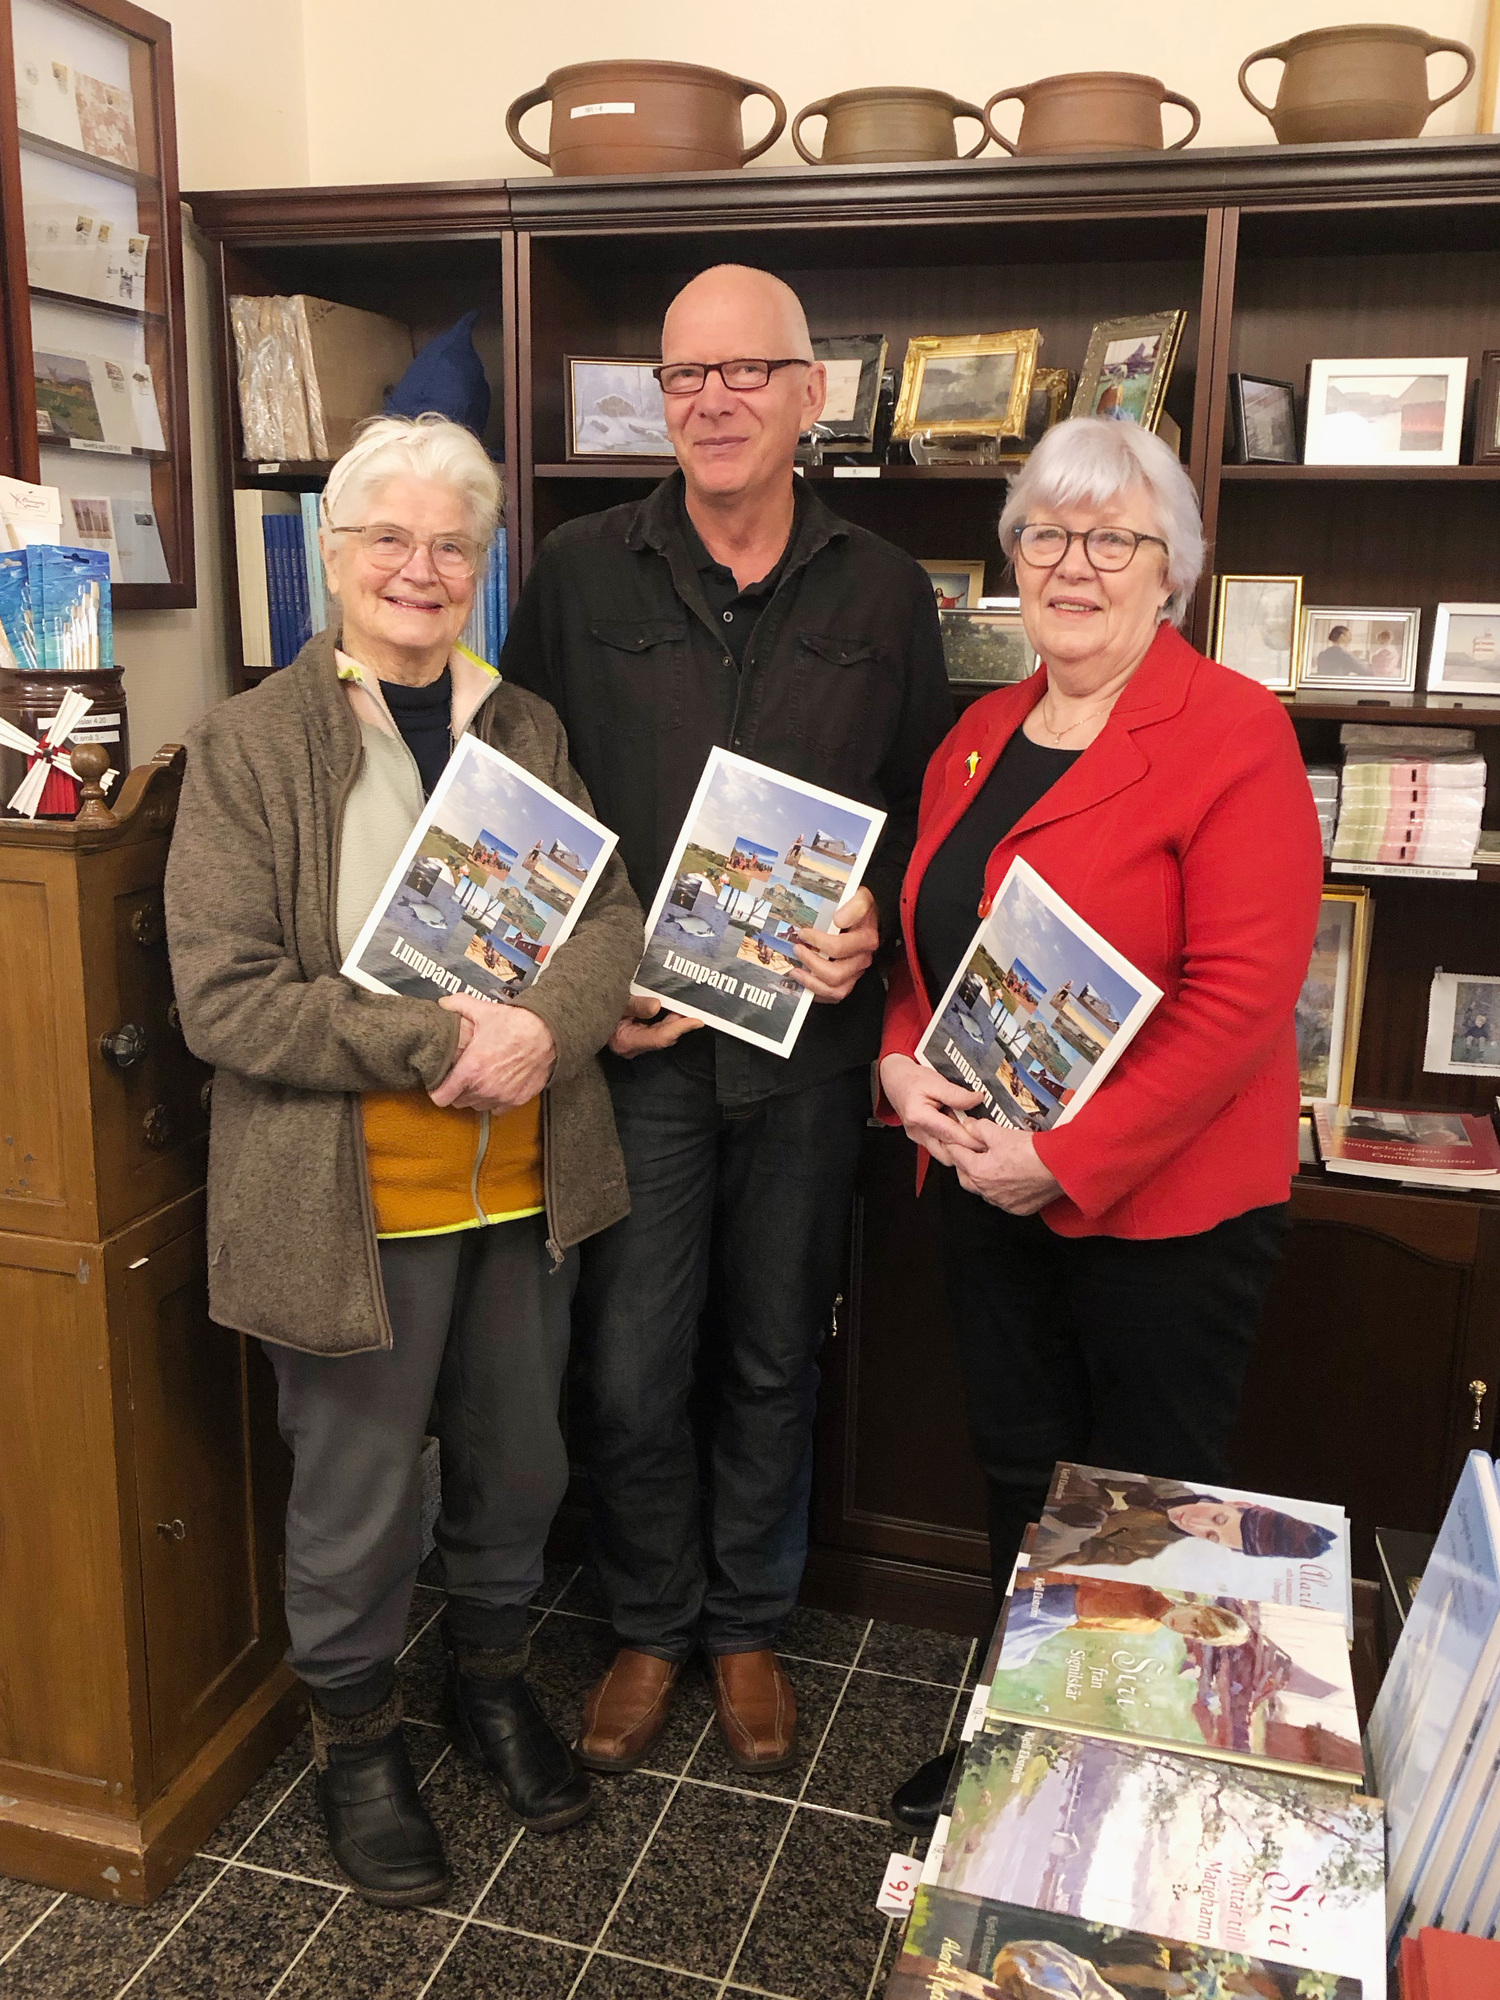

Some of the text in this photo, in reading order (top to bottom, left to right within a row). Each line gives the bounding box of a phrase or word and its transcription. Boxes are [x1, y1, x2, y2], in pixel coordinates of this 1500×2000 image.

[1352, 865, 1376, 873] STORA
[1383, 866, 1426, 875] SERVETTER
[389, 936, 463, 995] Lumparn
[662, 950, 778, 1011] Lumparn runt
[944, 1037, 994, 1109] Lumparn
[1030, 1577, 1046, 1618] Kjell Ekström
[1065, 1649, 1086, 1701] Signilskär
[1088, 1665, 1109, 1689] från
[1111, 1650, 1165, 1712] Siri
[1010, 1731, 1036, 1784] Kjell Ekström
[1196, 1859, 1223, 1941] Mariehamn
[1225, 1870, 1252, 1942] flyttar till
[1263, 1871, 1326, 1957] Siri
[936, 1937, 964, 1975] Alarik
